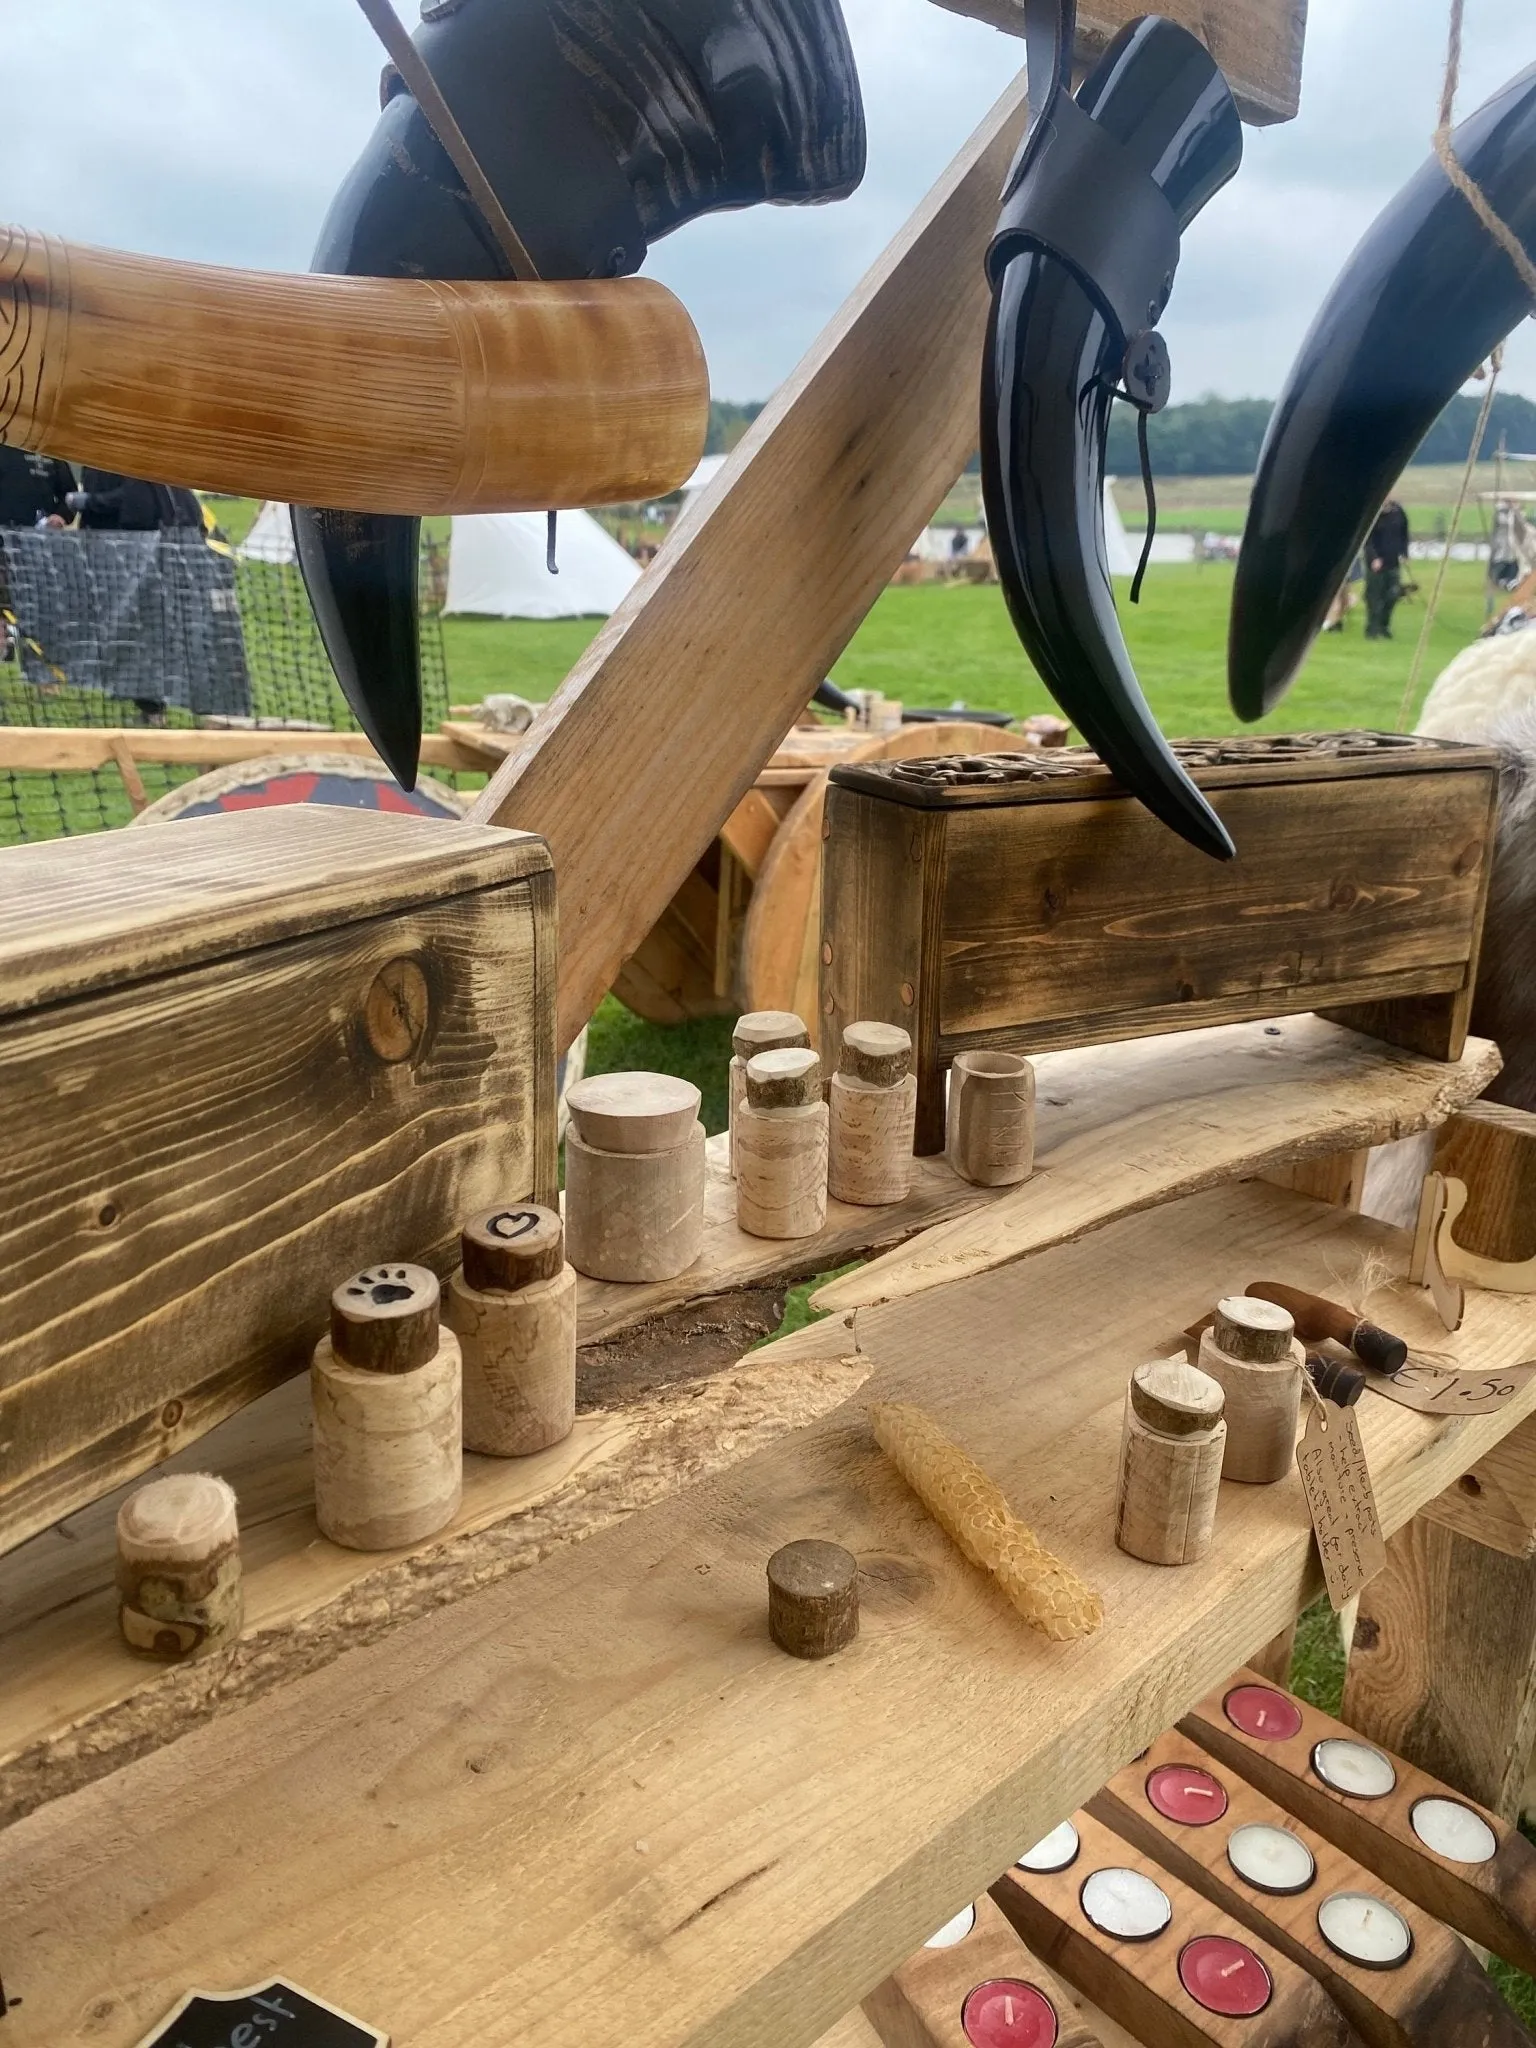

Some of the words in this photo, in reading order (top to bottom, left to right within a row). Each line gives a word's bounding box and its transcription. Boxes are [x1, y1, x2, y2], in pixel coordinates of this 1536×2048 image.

[1302, 1453, 1320, 1511] tablets
[1318, 1517, 1330, 1561] holder
[1312, 1448, 1324, 1483] Also
[1339, 1565, 1353, 1600] daily
[1340, 1447, 1351, 1477] help
[1349, 1484, 1367, 1534] extract
[1364, 1506, 1376, 1537] pots
[1345, 1528, 1364, 1577] preserve
